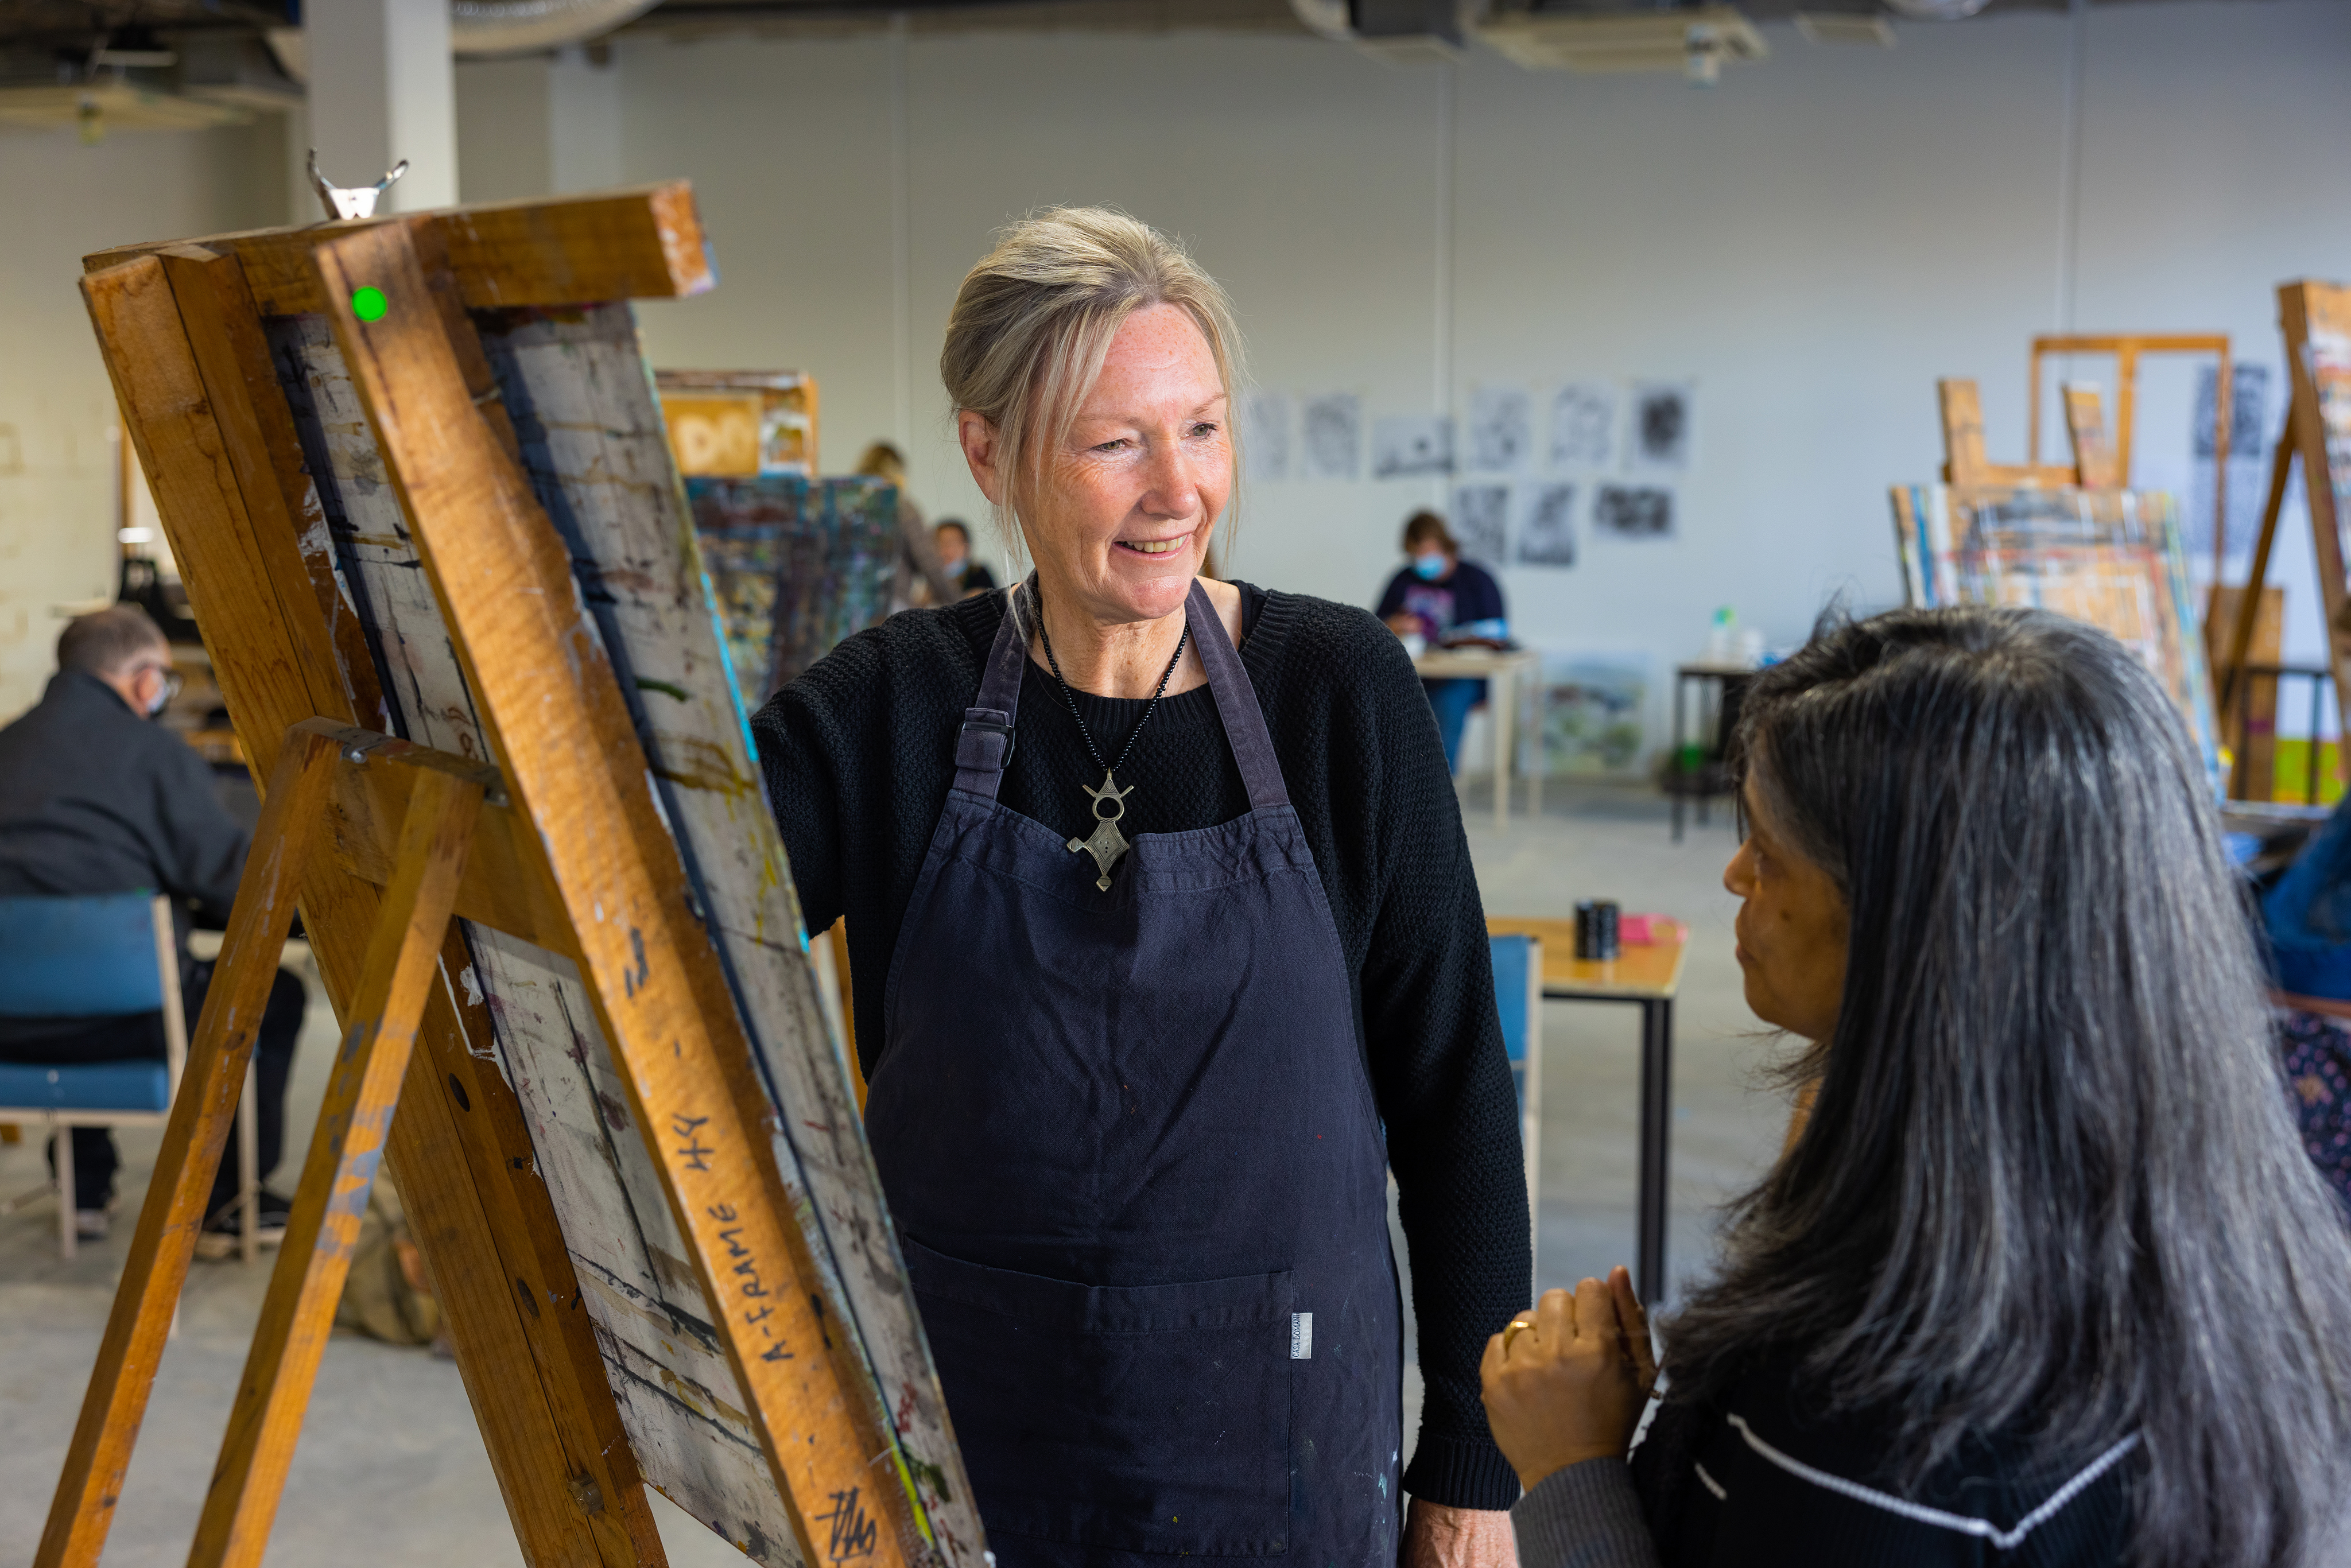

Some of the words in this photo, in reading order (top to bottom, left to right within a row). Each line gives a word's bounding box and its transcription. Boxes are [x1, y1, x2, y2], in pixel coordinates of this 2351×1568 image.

[707, 1202, 795, 1362] A-FRAME
[1293, 1315, 1301, 1340] DOMANI
[1292, 1342, 1300, 1358] CASA
